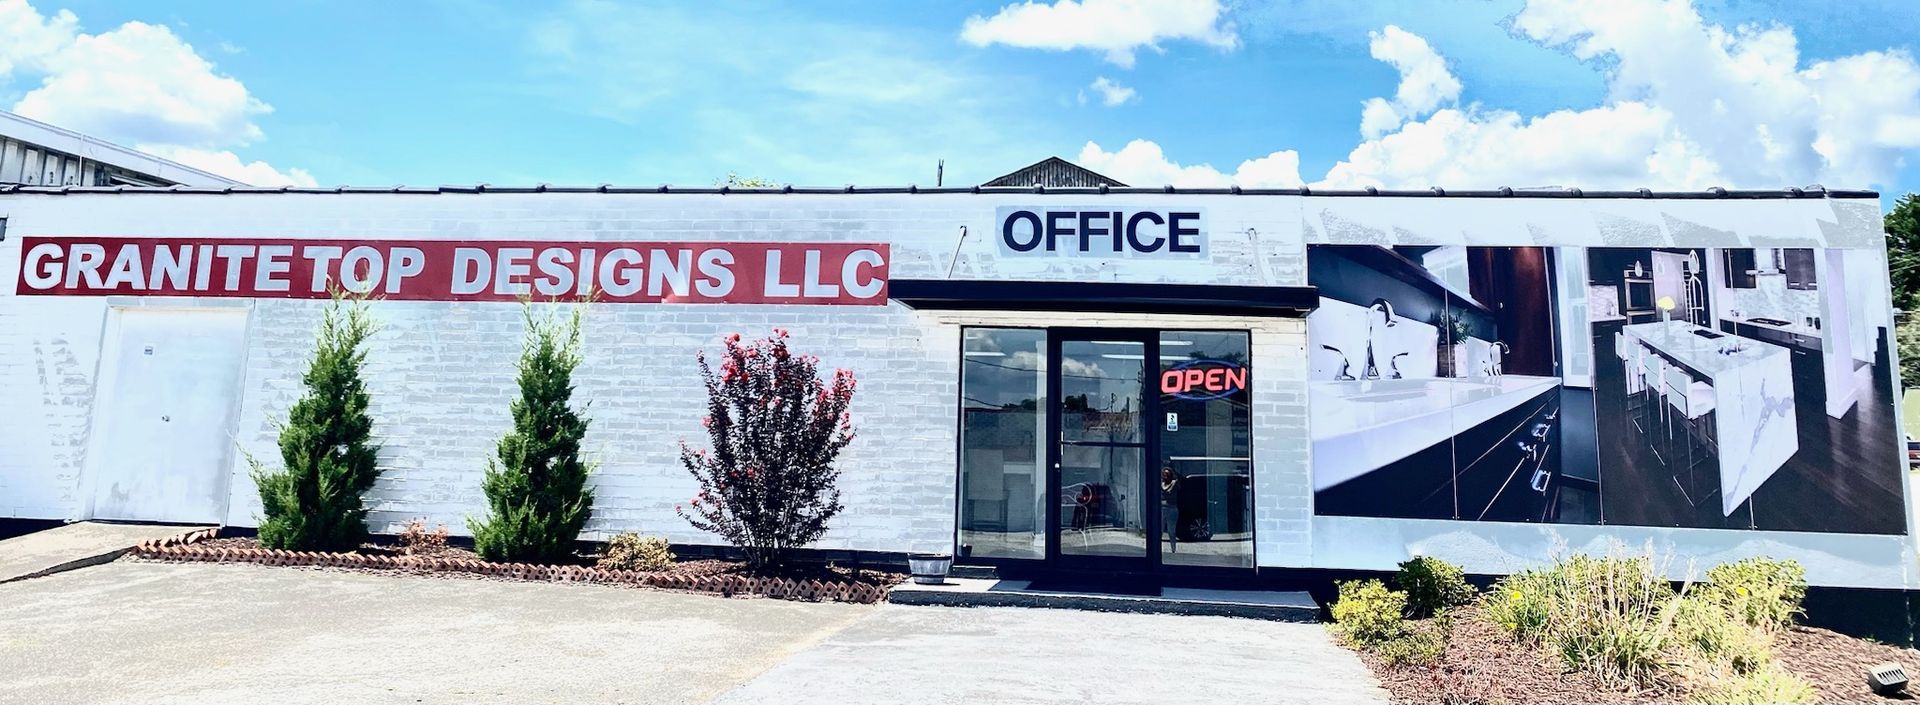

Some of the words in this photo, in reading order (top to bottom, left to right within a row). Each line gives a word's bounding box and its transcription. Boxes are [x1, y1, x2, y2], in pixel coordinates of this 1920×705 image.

[1002, 210, 1200, 253] OFFICE
[23, 243, 293, 291] GRANITE
[302, 246, 425, 294] TOP
[450, 247, 735, 297] DESIGNS
[763, 249, 885, 298] LLC
[1161, 367, 1246, 393] OPEN
